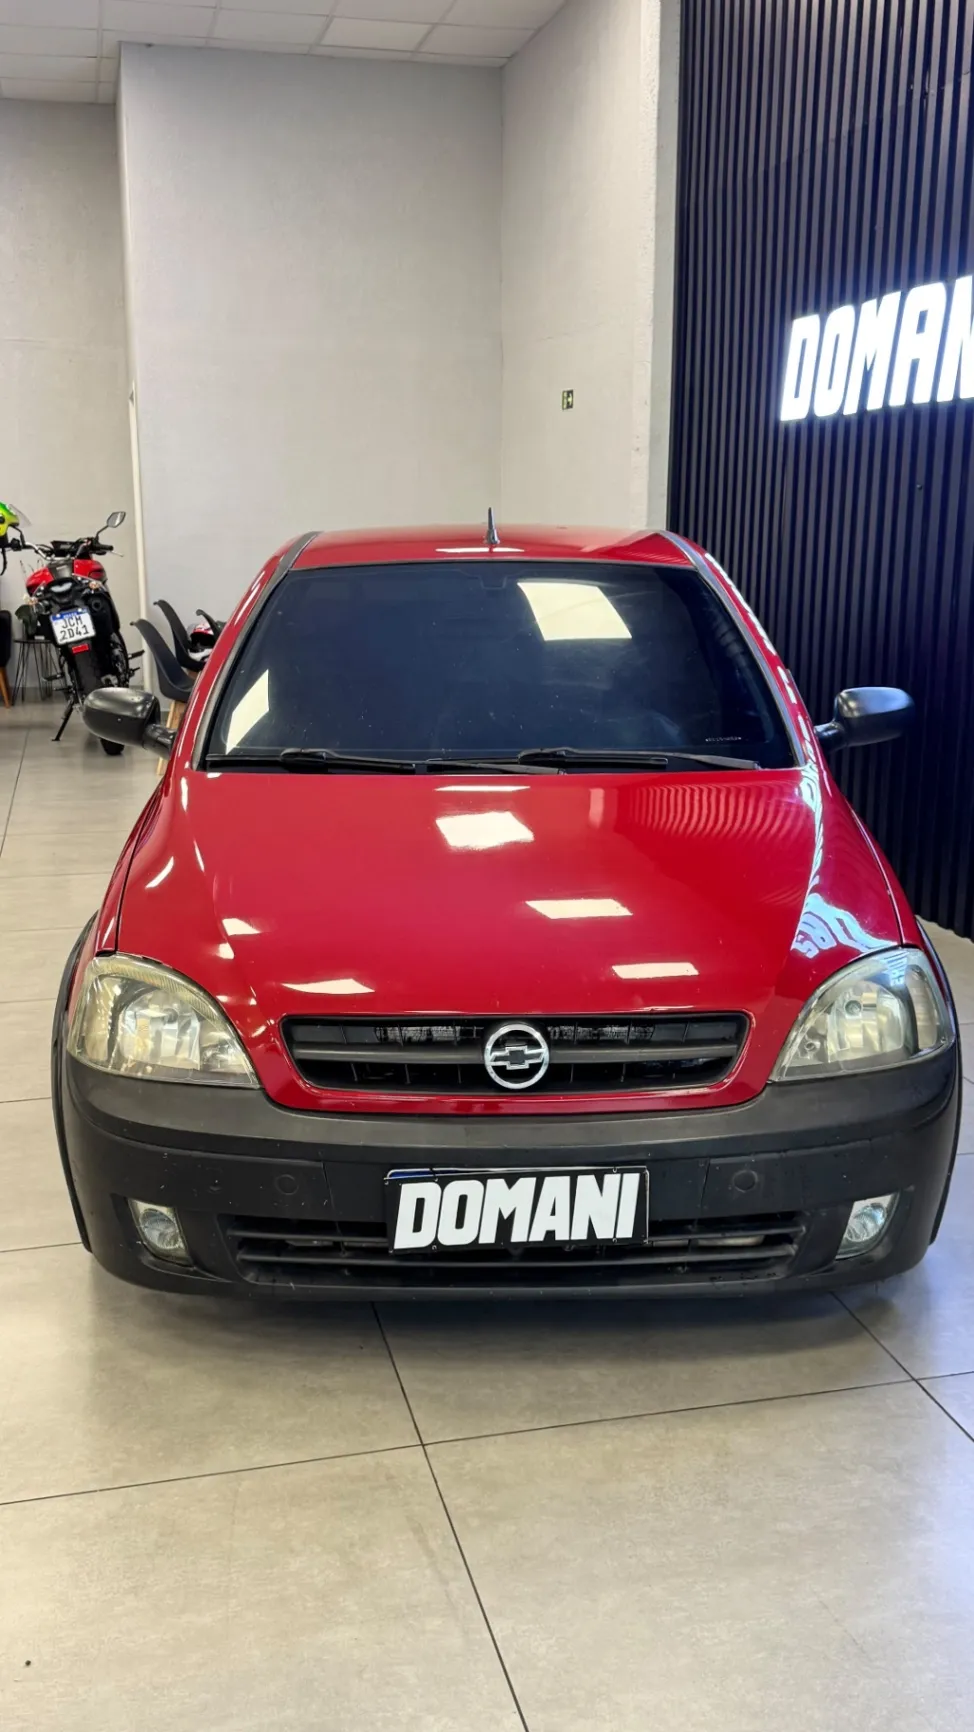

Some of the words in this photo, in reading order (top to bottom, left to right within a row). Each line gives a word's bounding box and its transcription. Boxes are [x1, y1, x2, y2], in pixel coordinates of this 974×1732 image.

[62, 615, 83, 629] JCM
[60, 624, 89, 641] 2D41
[393, 1173, 640, 1250] DOMANI
